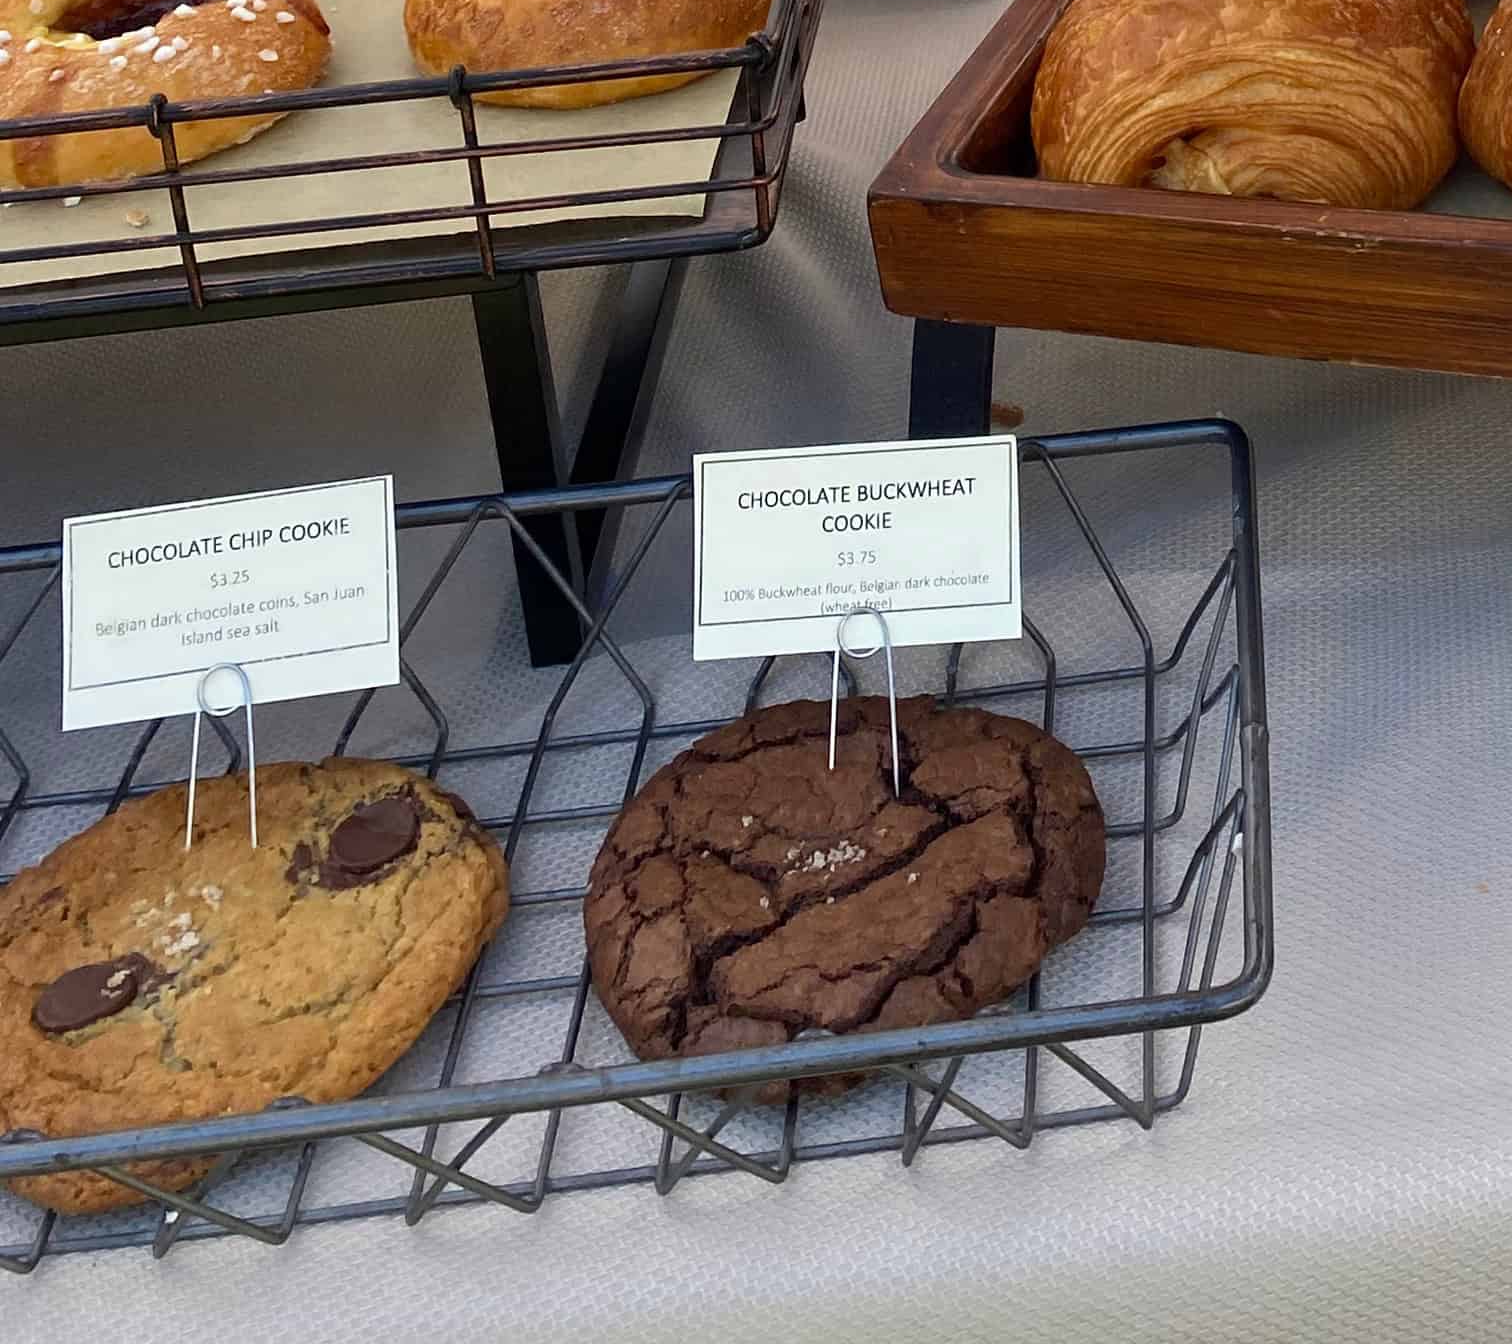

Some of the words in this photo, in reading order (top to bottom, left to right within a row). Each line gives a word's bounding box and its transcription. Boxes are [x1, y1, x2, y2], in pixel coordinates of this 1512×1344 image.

[737, 485, 851, 509] CHOCOLATE
[856, 477, 976, 502] BUCKWHEAT
[821, 511, 892, 533] COOKIE
[107, 535, 223, 569] CHOCOLATE
[228, 528, 273, 551] CHIP
[278, 517, 350, 543] COOKIE
[837, 549, 876, 567] $3.75
[209, 568, 250, 589] $3.25
[722, 588, 755, 602] 100%
[757, 583, 822, 600] Buckwheat
[859, 578, 901, 594] Belgian
[904, 575, 930, 589] dark
[932, 573, 989, 587] chocolate
[94, 618, 146, 637] Belgian
[149, 610, 182, 628] dark
[185, 601, 255, 623] chocolate
[303, 590, 329, 605] San
[333, 585, 365, 600] Juan
[180, 625, 223, 646] Island
[226, 625, 250, 639] sea
[254, 617, 279, 636] salt
